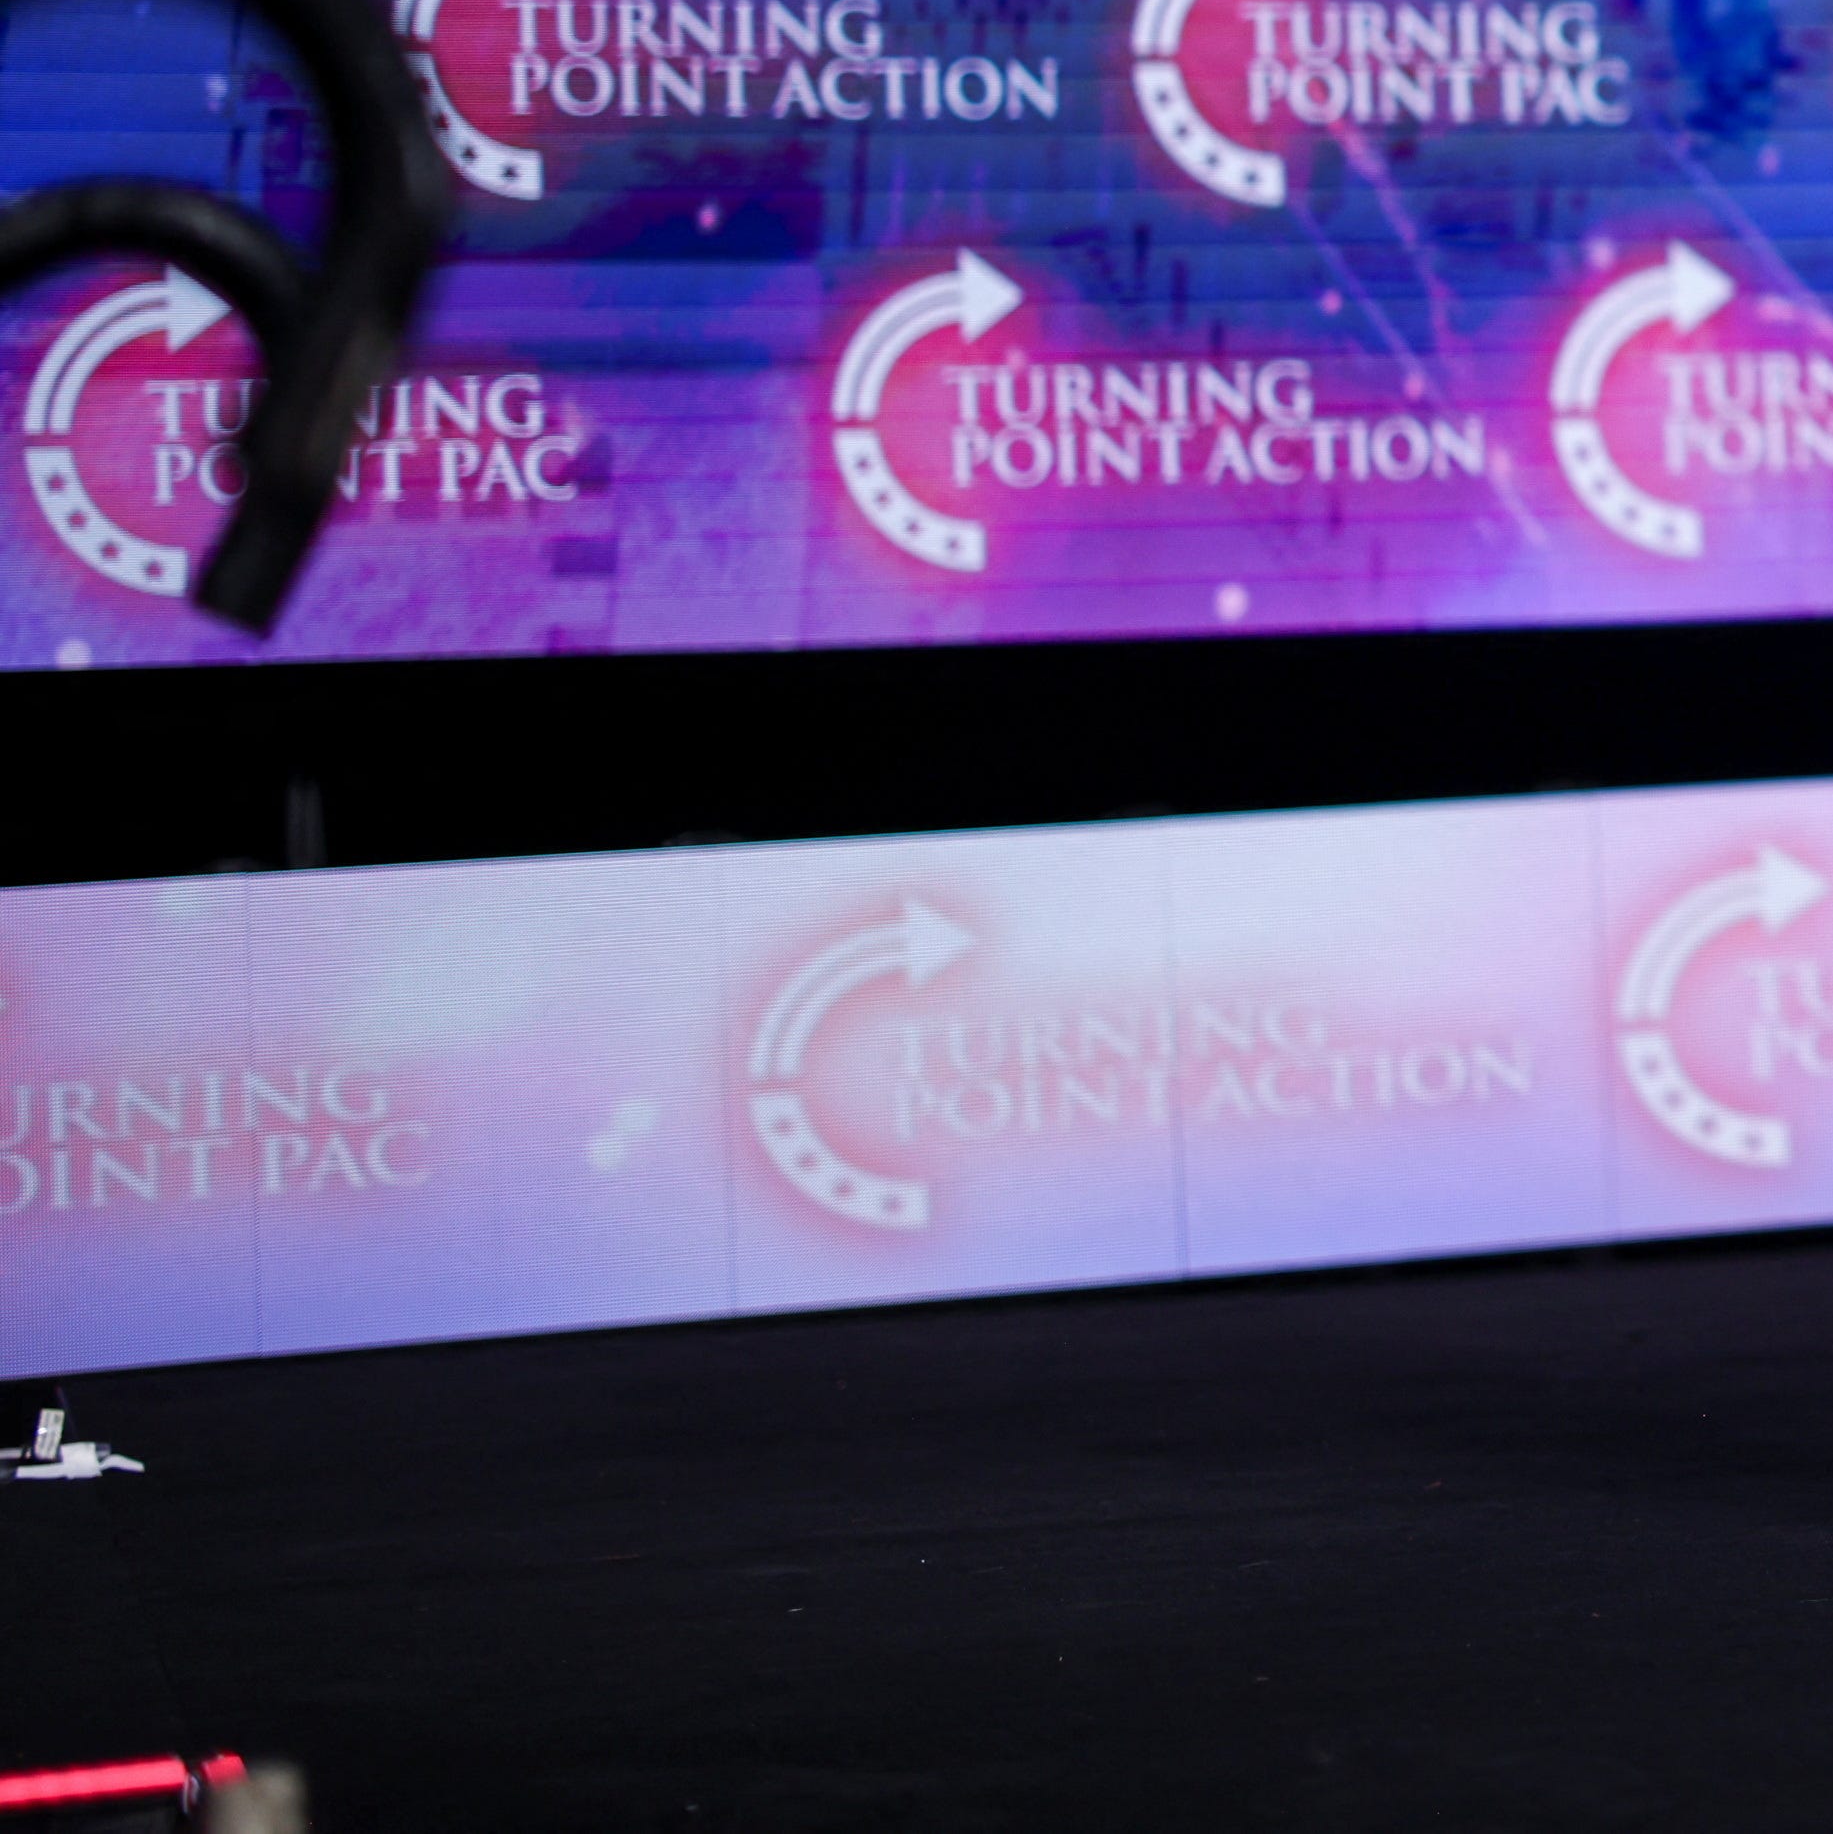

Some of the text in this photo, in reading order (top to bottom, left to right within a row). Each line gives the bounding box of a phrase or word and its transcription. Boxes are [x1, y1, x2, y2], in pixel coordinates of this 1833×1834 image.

[1241, 2, 1597, 63] TURNING
[511, 55, 1059, 119] POINT ACTION
[1249, 62, 1631, 125] POINT PAC
[145, 374, 544, 439] TUING
[944, 363, 1310, 424] TURNING
[438, 436, 578, 502] PAC
[952, 420, 1485, 488] POINT ACTION
[896, 1002, 1327, 1076] TURNING
[0, 1066, 391, 1149] URNING
[893, 1042, 1532, 1141] POINT ACTION
[0, 1120, 432, 1215] OINT PAC
